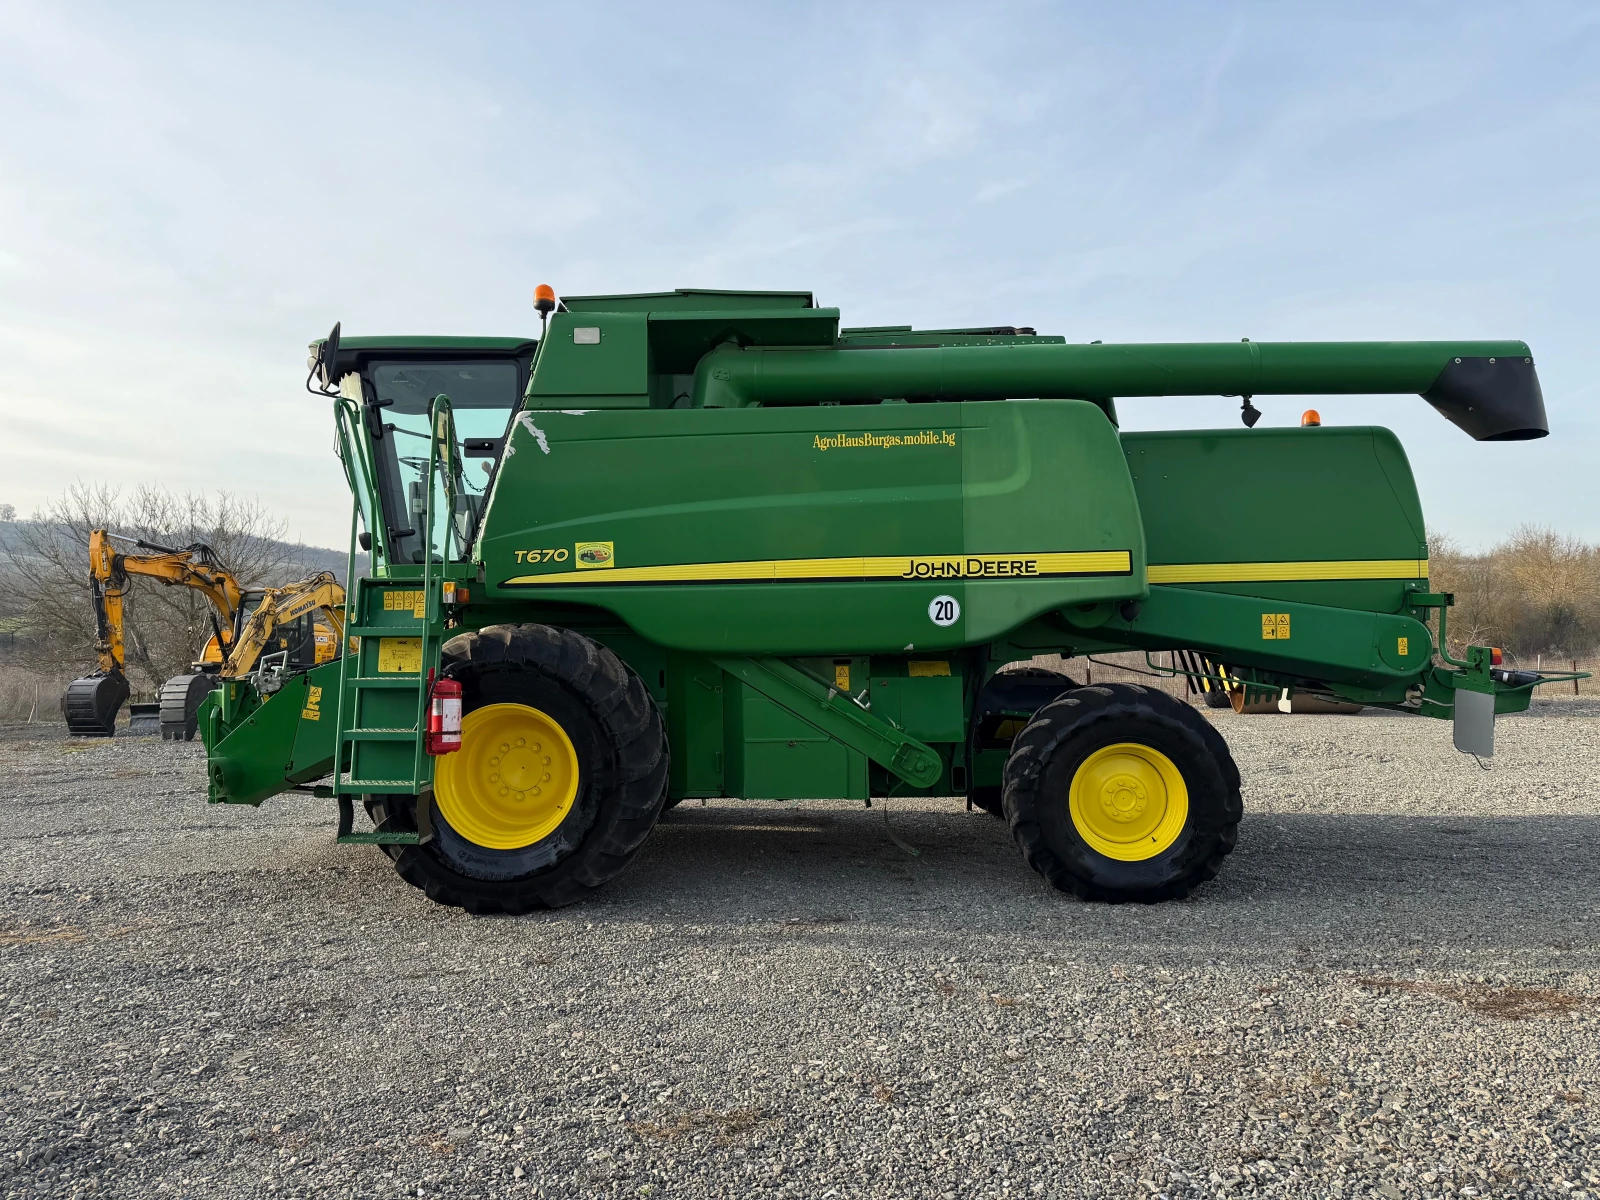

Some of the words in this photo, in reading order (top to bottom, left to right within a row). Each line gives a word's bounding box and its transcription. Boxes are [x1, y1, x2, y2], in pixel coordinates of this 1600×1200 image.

[813, 431, 956, 451] AgroHausBurgas.mobile.bg
[514, 548, 569, 564] T670
[902, 560, 961, 577] JOHN
[966, 558, 1038, 575] DEERE
[289, 599, 316, 617] KOMATSU
[934, 600, 954, 621] 20
